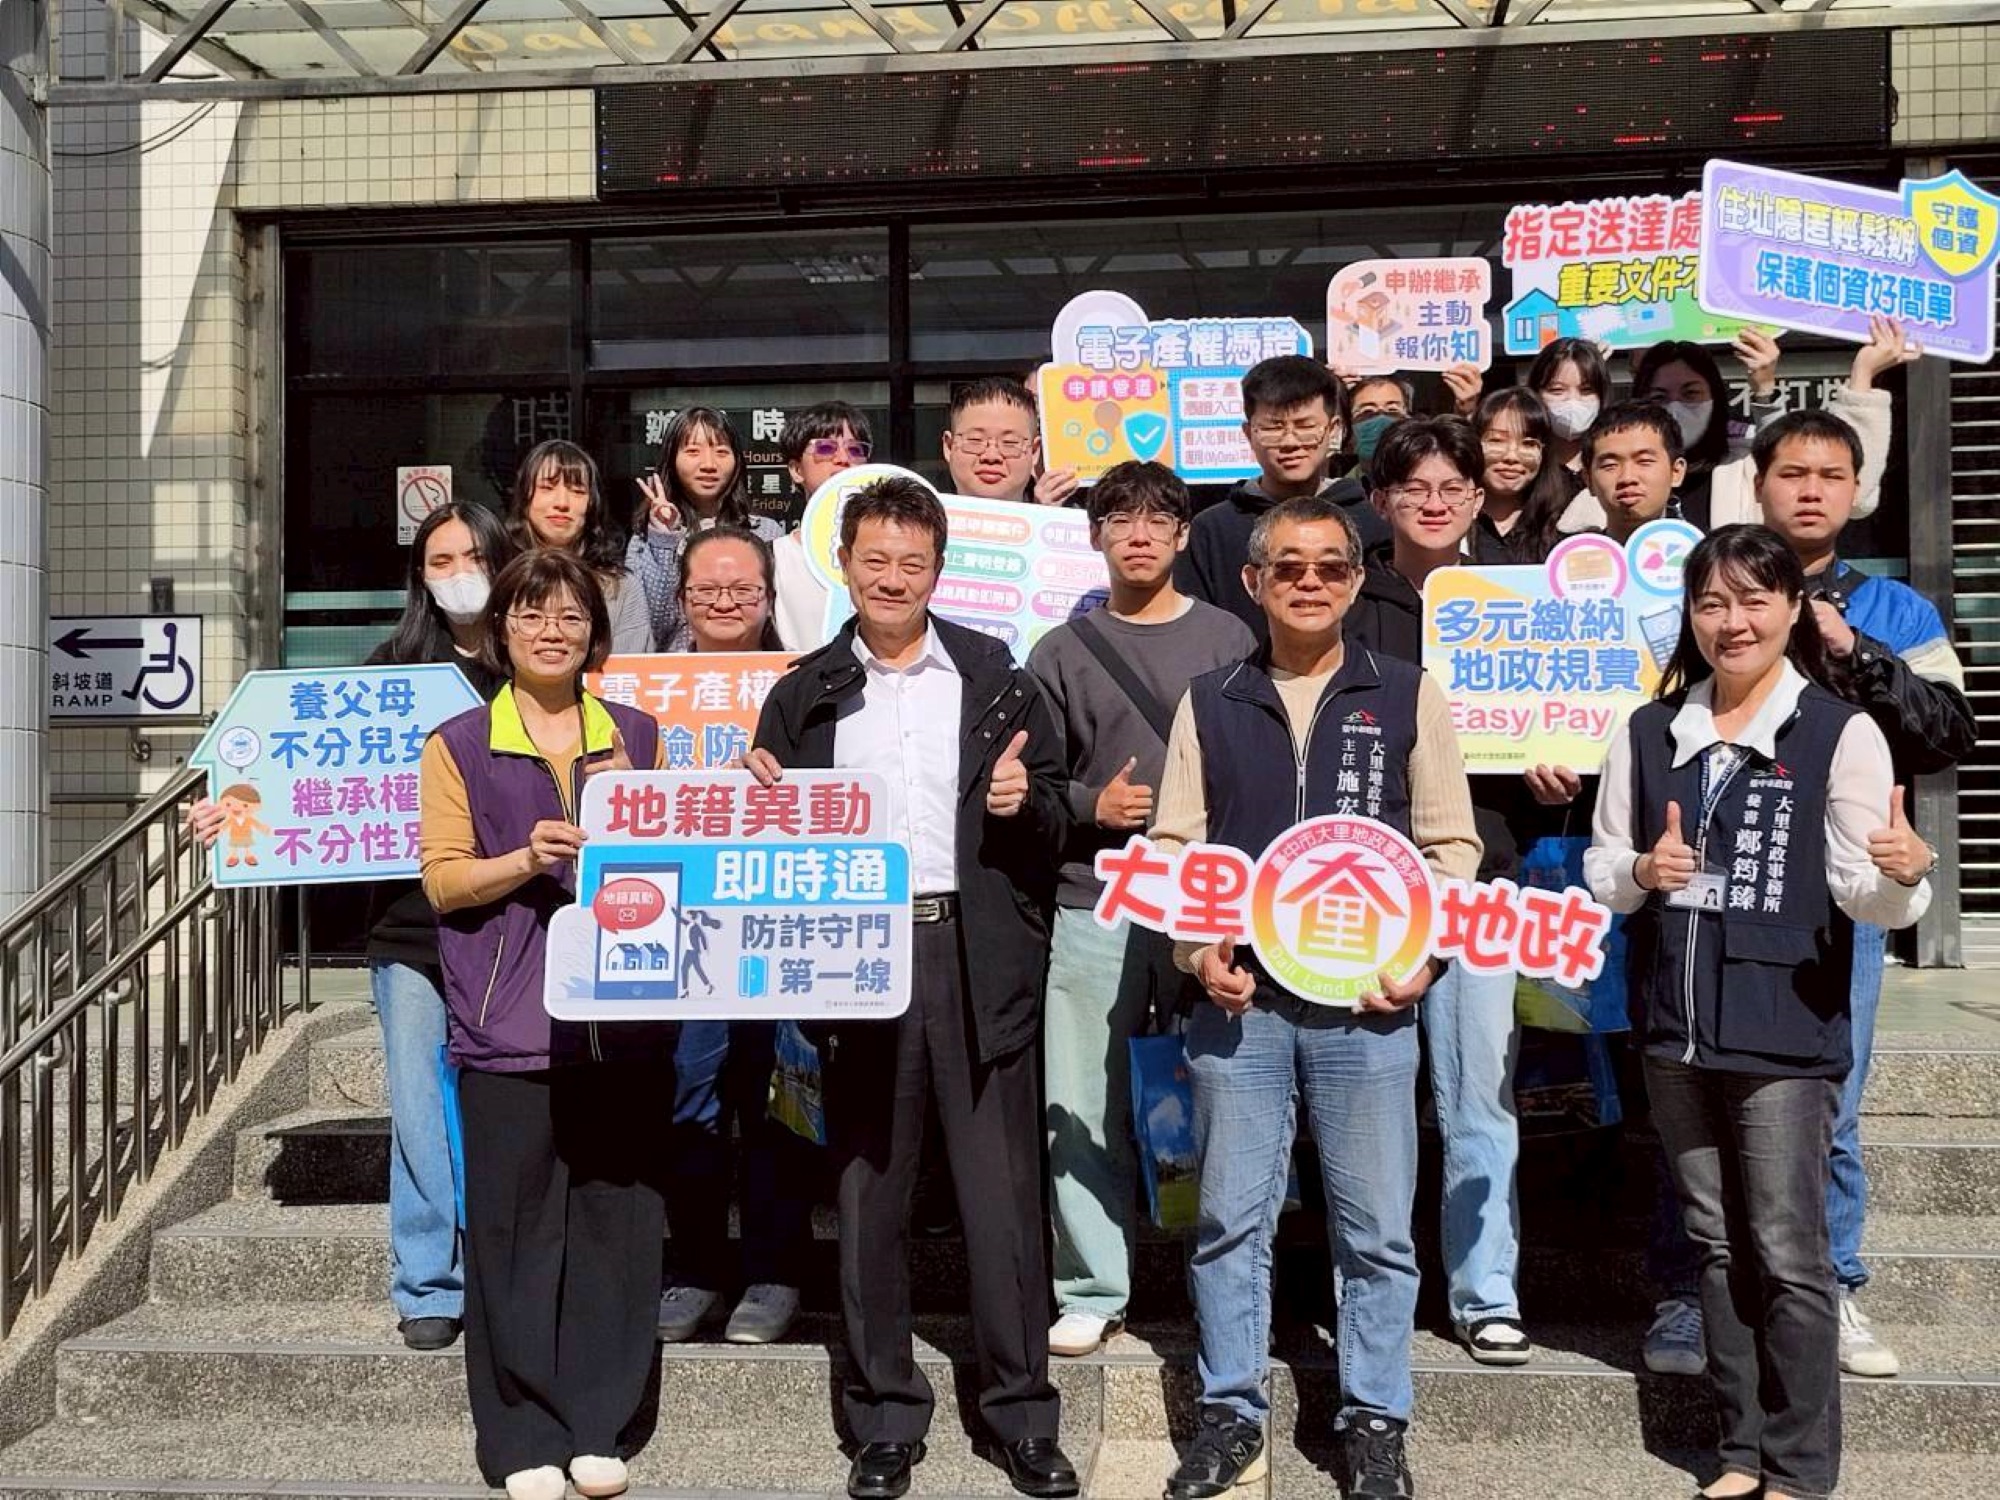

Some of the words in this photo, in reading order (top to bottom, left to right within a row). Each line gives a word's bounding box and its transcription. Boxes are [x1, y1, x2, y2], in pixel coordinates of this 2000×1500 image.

[1506, 198, 1701, 264] 指定送達處
[1716, 186, 1919, 267] 住址隱匿輕鬆辦
[1931, 202, 1980, 230] 守護
[1931, 229, 1980, 257] 個資
[1385, 269, 1482, 294] 申辦繼承
[1754, 249, 1955, 327] 保護個資好簡單
[1418, 301, 1472, 327] 主動
[1076, 321, 1300, 370] 電子產權憑證
[1395, 330, 1480, 363] 報你知
[752, 499, 791, 512] Friday
[1435, 599, 1625, 643] 多元繳納
[52, 672, 113, 691] 斜坡道
[1450, 648, 1642, 692] 地政規費
[52, 694, 113, 707] RAMP
[289, 678, 416, 720] 養父母
[1450, 702, 1531, 737] Easy
[1543, 702, 1612, 737] Pay
[269, 724, 429, 769] 不分兒女
[1341, 739, 1357, 766] 主任
[292, 773, 421, 817] 繼承權
[606, 782, 871, 838] 地籍異動
[712, 848, 888, 900] 即時通
[1763, 796, 1794, 913] 大里地政事務所
[1101, 844, 1249, 937] 大里
[1438, 886, 1603, 978] 地政
[741, 913, 891, 950] 防詐守門
[779, 959, 892, 994] 第一線
[1301, 975, 1346, 995] Land
